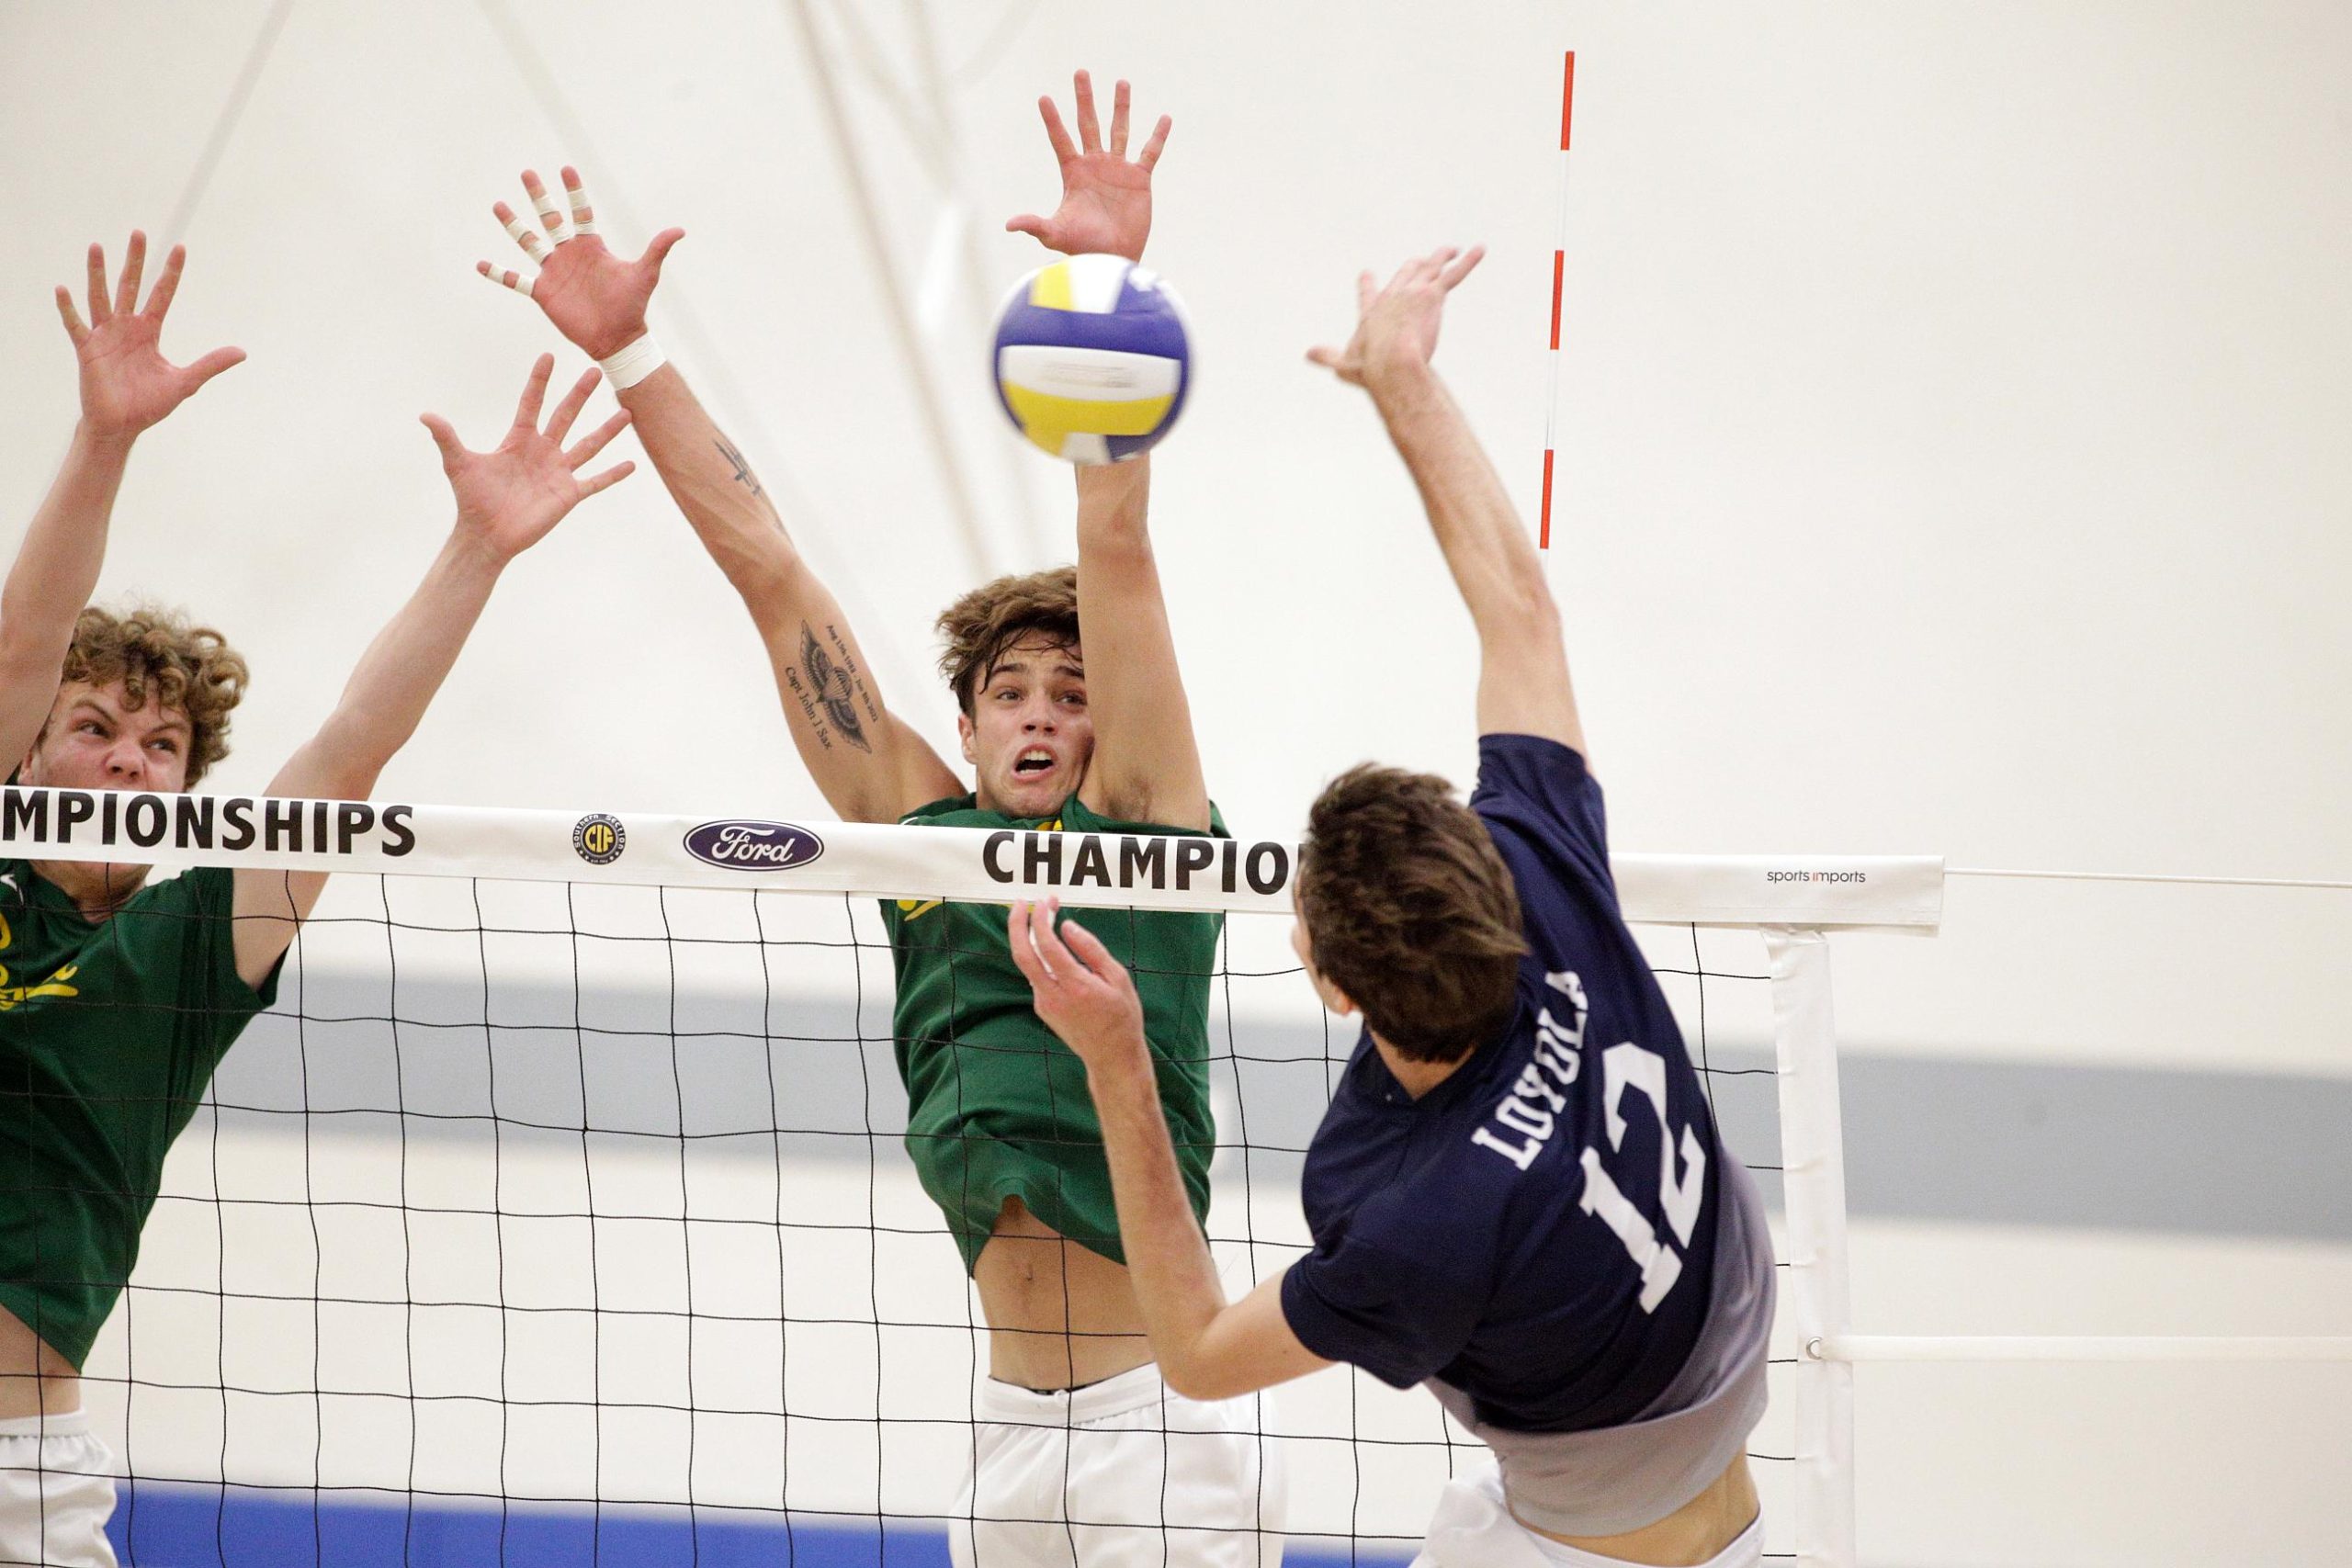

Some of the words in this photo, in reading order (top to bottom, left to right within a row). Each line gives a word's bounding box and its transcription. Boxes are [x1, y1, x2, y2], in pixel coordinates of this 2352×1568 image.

[785, 667, 802, 694] Capt
[799, 694, 817, 720] John
[812, 719, 823, 728] J
[816, 728, 832, 750] Sax
[2, 789, 416, 857] MPIONSHIPS
[573, 814, 599, 848] Southern
[605, 814, 626, 849] Section
[585, 824, 614, 853] CIF
[711, 826, 796, 863] Ford
[982, 831, 1306, 896] CHAMPIO
[1767, 869, 1810, 884] sports
[1812, 870, 1866, 885] imports
[1472, 971, 1589, 1171] LOYOLA
[1579, 1041, 1706, 1314] 12
